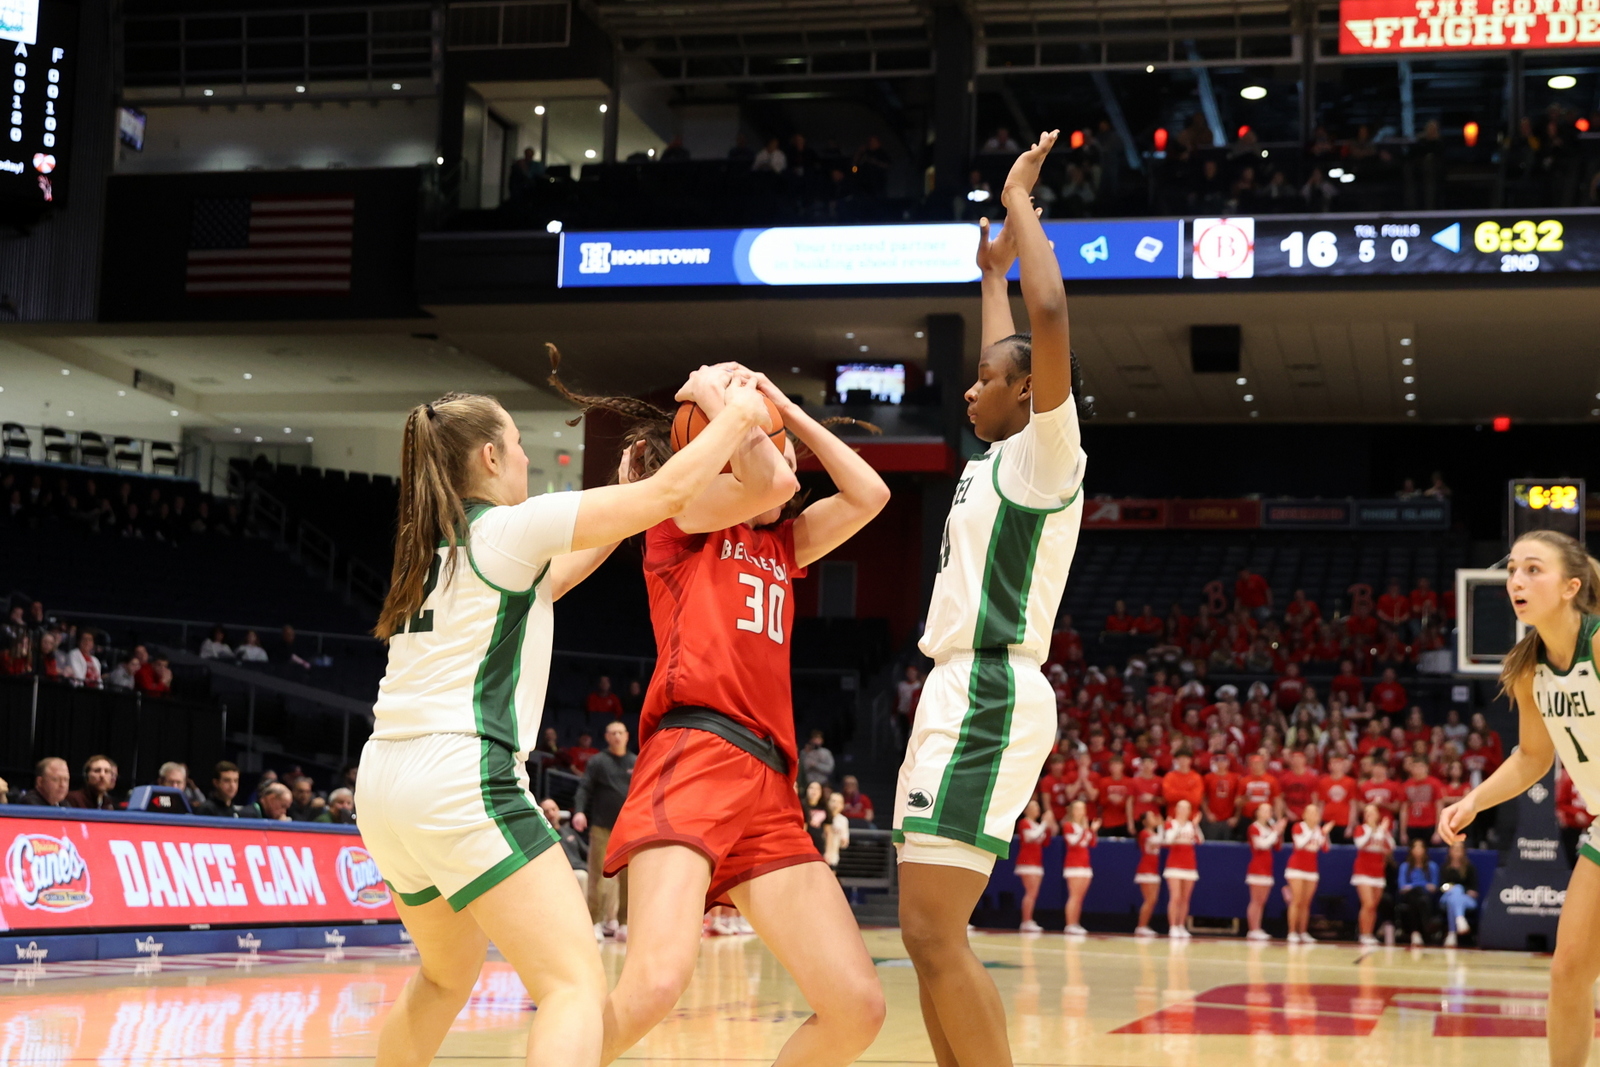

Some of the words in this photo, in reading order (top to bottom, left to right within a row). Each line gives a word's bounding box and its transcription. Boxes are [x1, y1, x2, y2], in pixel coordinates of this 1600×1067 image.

[1415, 1, 1477, 18] THE
[1373, 14, 1536, 48] FLIGHT
[15, 42, 28, 58] A
[52, 47, 64, 64] F
[15, 62, 26, 77] 0
[48, 68, 60, 83] 0
[14, 79, 25, 94] 0
[47, 84, 59, 99] 0
[12, 95, 22, 110] 1
[46, 101, 55, 115] 1
[45, 116, 57, 131] 0
[10, 127, 22, 142] 0
[43, 132, 55, 148] 0
[1381, 224, 1420, 237] FOULS
[1474, 220, 1564, 253] 6:32
[611, 248, 711, 266] HOMETOWN
[831, 240, 885, 252] trusted
[890, 240, 947, 253] partner
[1280, 231, 1338, 268] 16
[1358, 239, 1376, 263] 5
[1391, 238, 1409, 263] 0
[1500, 254, 1540, 272] 2ND
[1529, 485, 1577, 509] 6:32
[736, 572, 786, 645] 30
[1564, 726, 1589, 763] 1
[1517, 837, 1559, 849] Premier
[1520, 848, 1557, 860] Health
[12, 834, 84, 906] Cane's
[109, 839, 249, 907] DANCE
[244, 844, 327, 906] CAM
[1499, 884, 1568, 908] altafibe
